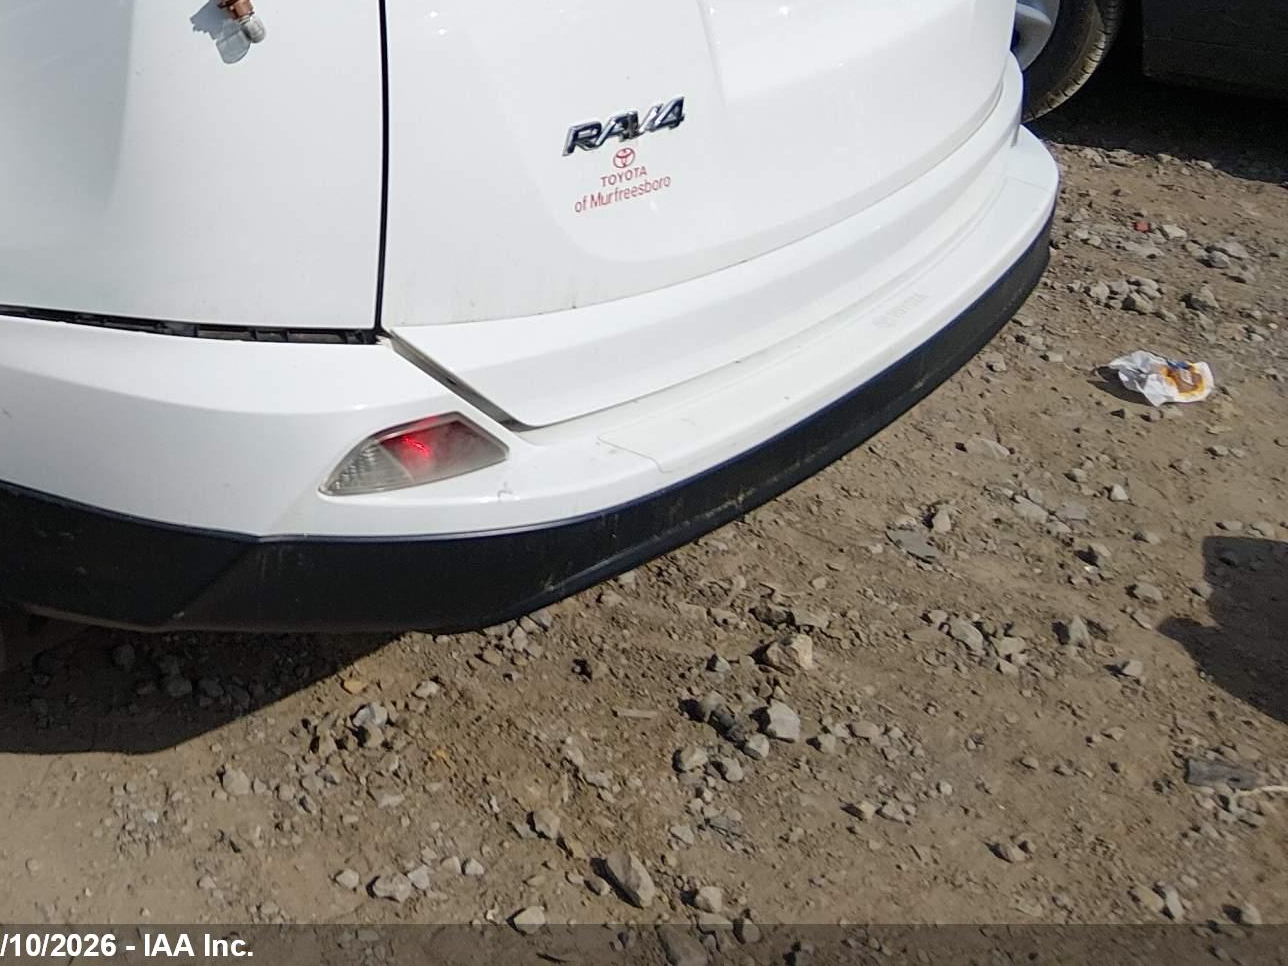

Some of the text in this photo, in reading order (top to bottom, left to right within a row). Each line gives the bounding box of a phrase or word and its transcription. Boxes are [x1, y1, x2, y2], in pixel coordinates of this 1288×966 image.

[561, 95, 686, 157] RAV4
[574, 175, 672, 213] of Murfreesboro
[600, 165, 648, 187] TOYOTA
